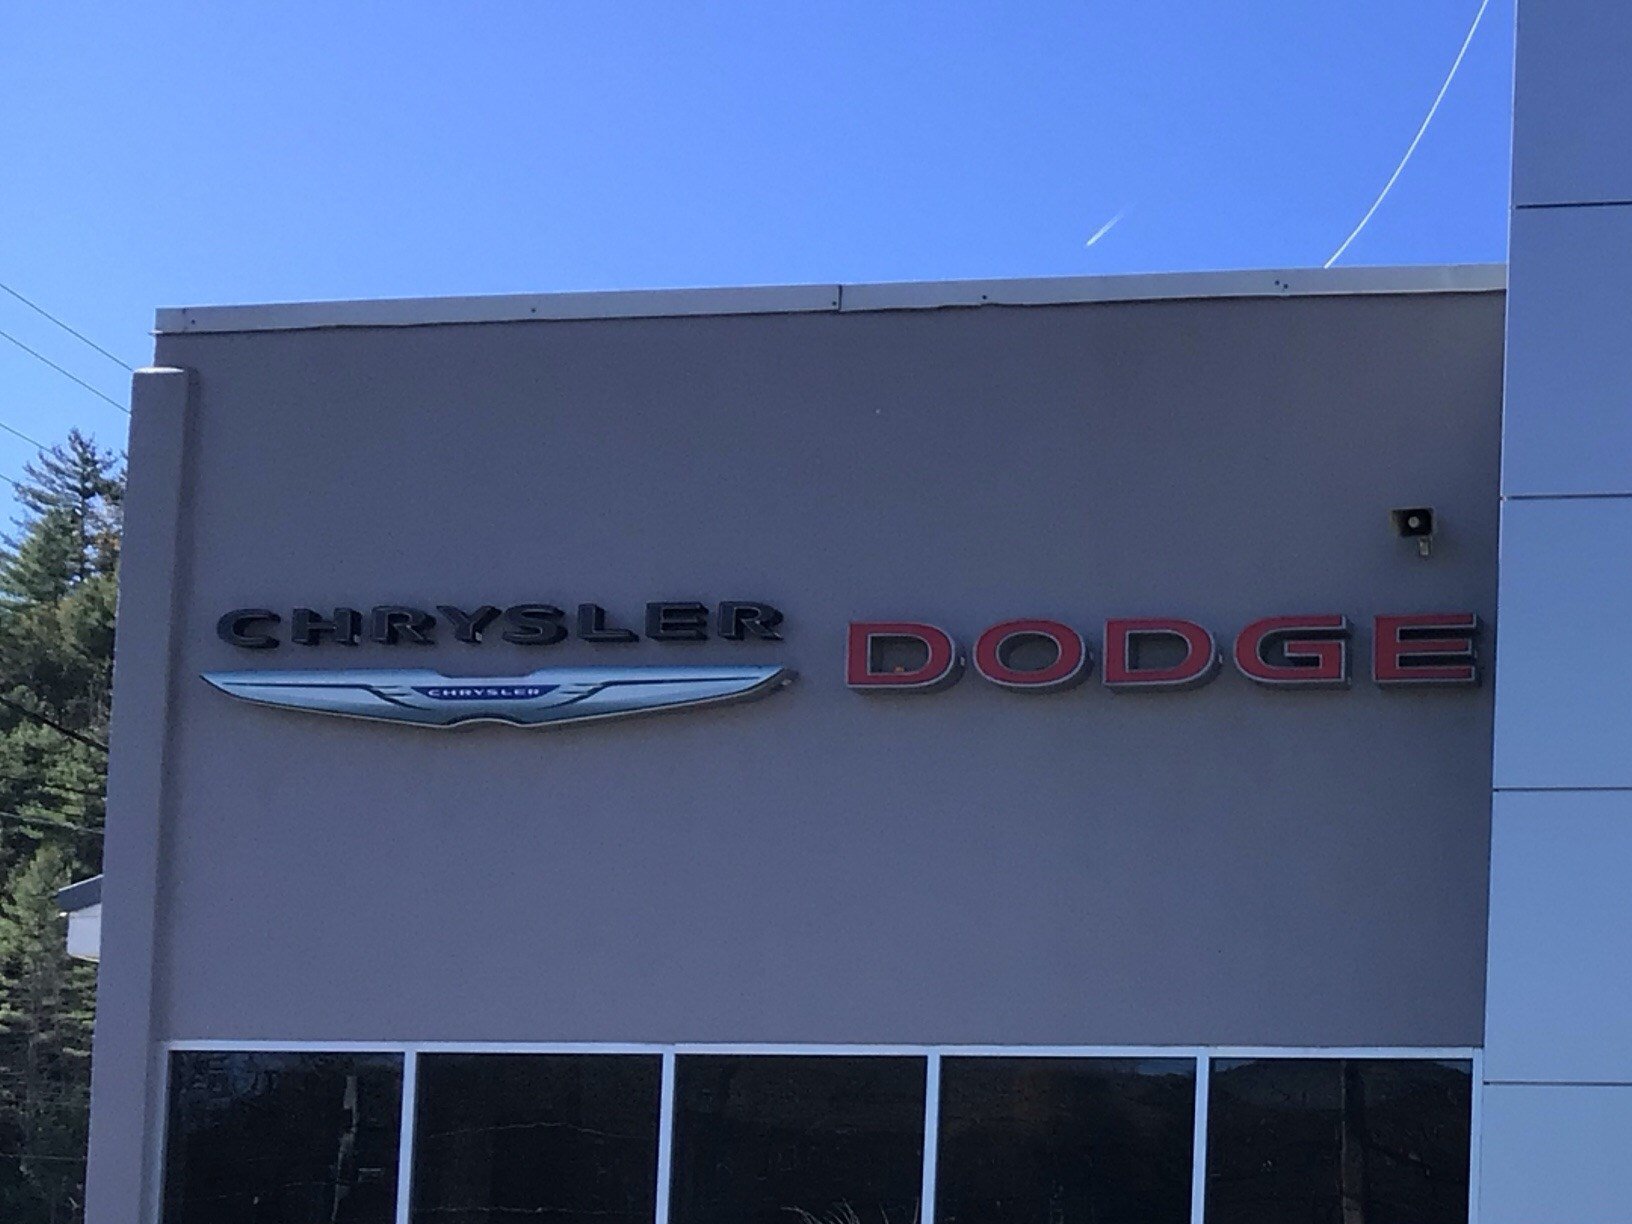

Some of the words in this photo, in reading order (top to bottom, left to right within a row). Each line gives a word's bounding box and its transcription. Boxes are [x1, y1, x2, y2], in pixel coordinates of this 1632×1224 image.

[216, 602, 784, 649] CHRYSLER
[846, 613, 1482, 692] DODGE
[428, 688, 540, 697] CHRYSLER
